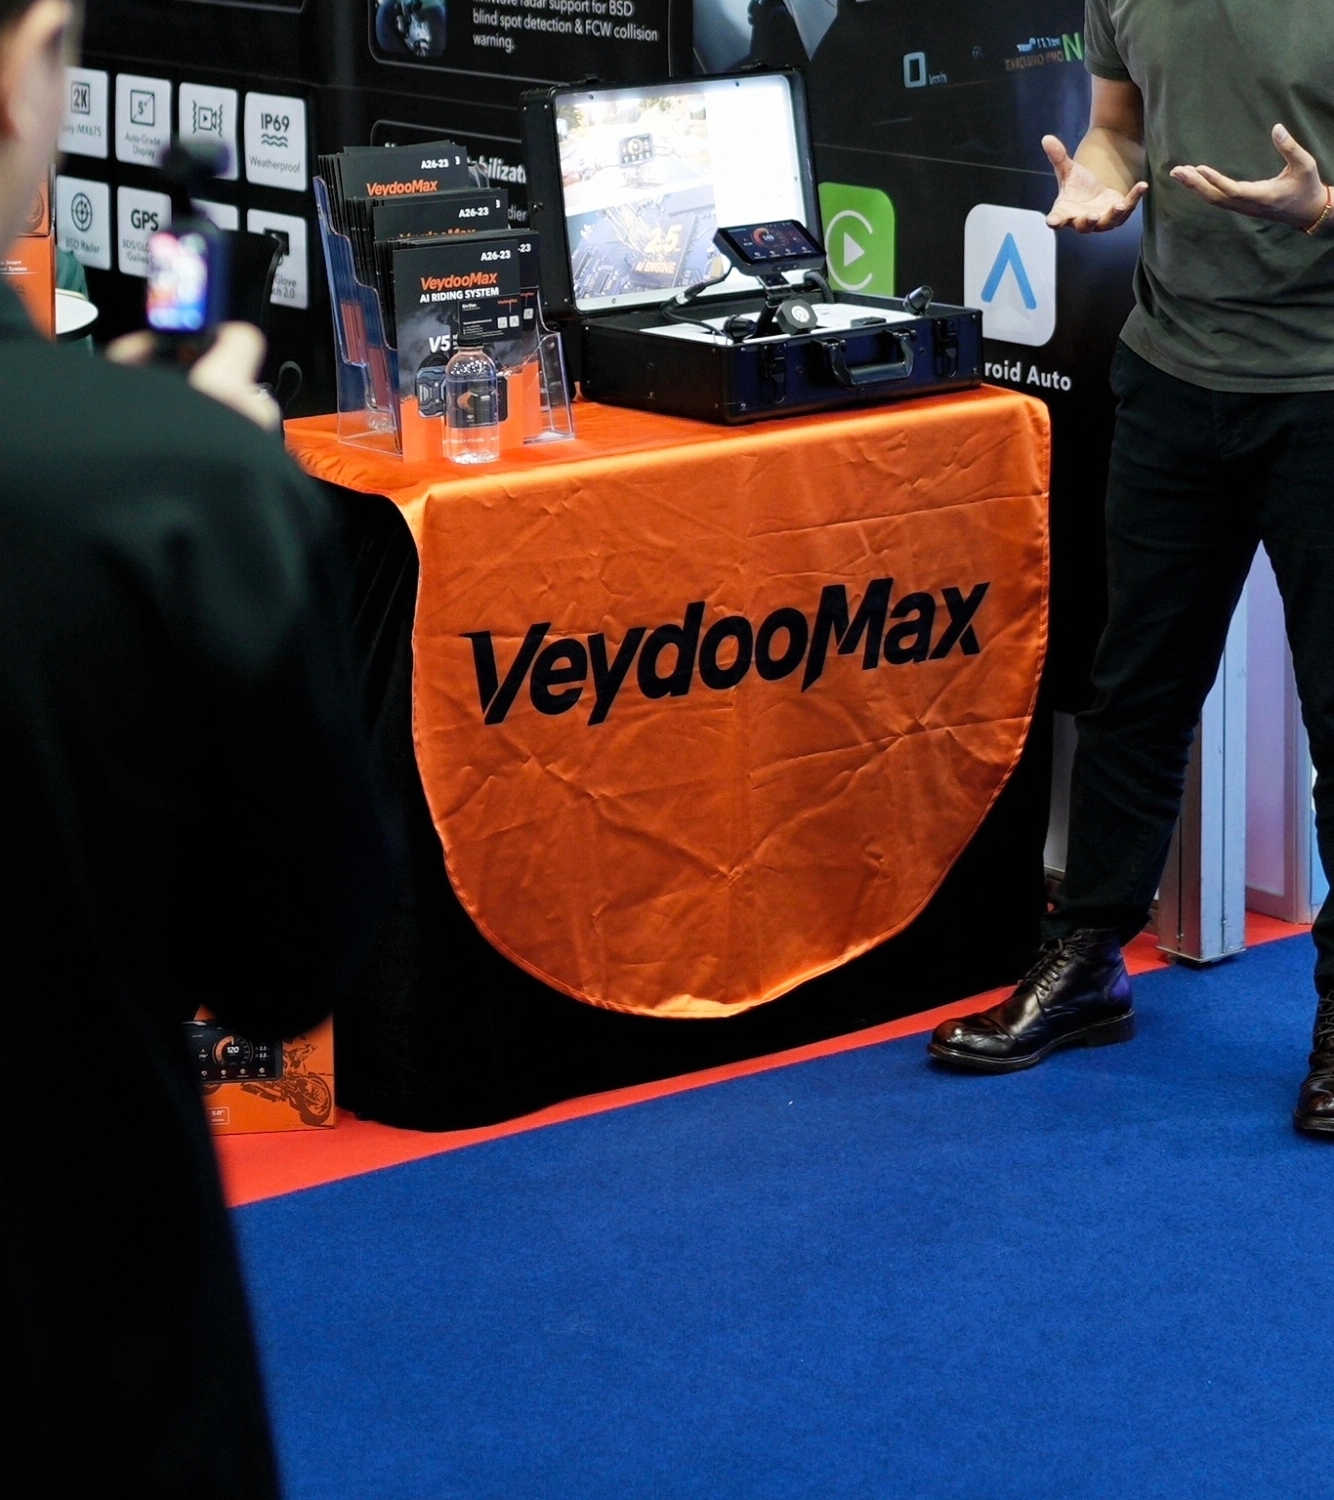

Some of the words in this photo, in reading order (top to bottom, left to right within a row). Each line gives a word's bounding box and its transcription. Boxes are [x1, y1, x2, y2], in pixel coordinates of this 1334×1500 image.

[608, 0, 633, 17] BSD
[472, 9, 498, 26] blind
[499, 12, 523, 31] spot
[523, 15, 572, 34] detection
[574, 19, 583, 35] &
[585, 19, 611, 37] FCW
[613, 23, 658, 42] collision
[472, 33, 515, 53] warning.
[1061, 32, 1084, 62] N
[72, 88, 88, 109] 2K
[260, 112, 290, 132] IP69
[248, 155, 301, 174] Weatherproof
[420, 158, 449, 170] A26-23
[366, 179, 438, 197] VeydooMax
[130, 209, 159, 232] GPS
[458, 206, 489, 219] A26-23
[81, 239, 101, 254] Radar
[480, 250, 511, 262] A26-23
[420, 272, 498, 291] VeydooMax
[419, 294, 430, 304] AI
[431, 289, 463, 302] RIDING
[464, 286, 499, 299] SYSTEM
[428, 335, 451, 353] V5
[984, 360, 1021, 382] roid
[1026, 365, 1071, 391] Auto
[461, 577, 990, 726] VeydooMax
